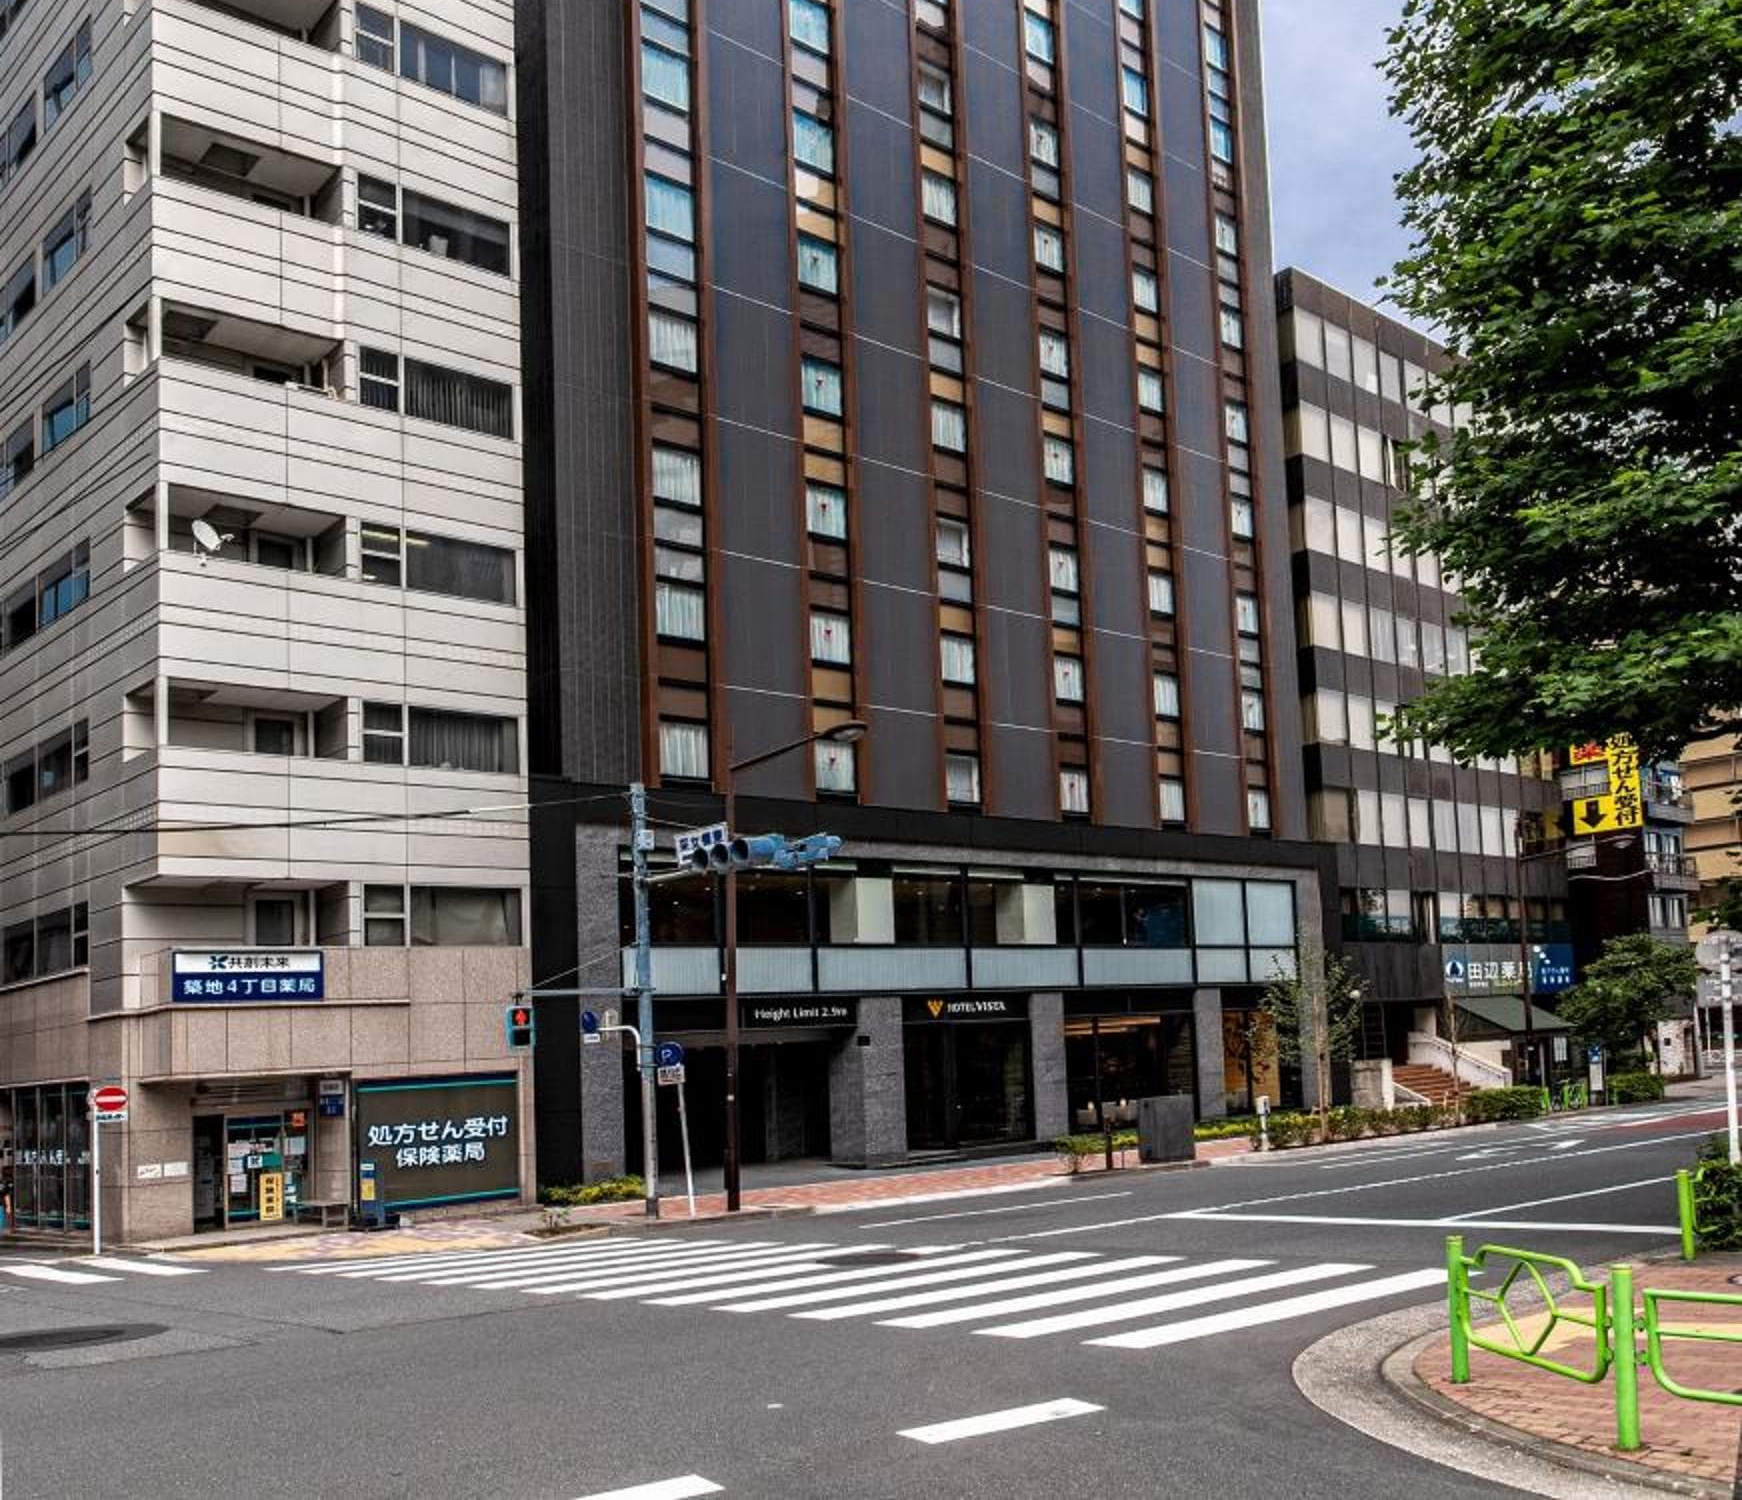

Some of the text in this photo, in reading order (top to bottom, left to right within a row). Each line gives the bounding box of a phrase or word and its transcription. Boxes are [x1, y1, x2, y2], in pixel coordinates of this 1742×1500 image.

[183, 978, 316, 995] 築地4丁目薬局
[755, 1007, 791, 1021] Height
[793, 1007, 819, 1018] Limit
[947, 1001, 1007, 1013] HOTEL VISTA
[367, 1115, 508, 1147] 処方せん受付
[395, 1141, 485, 1168] 保険薬局
